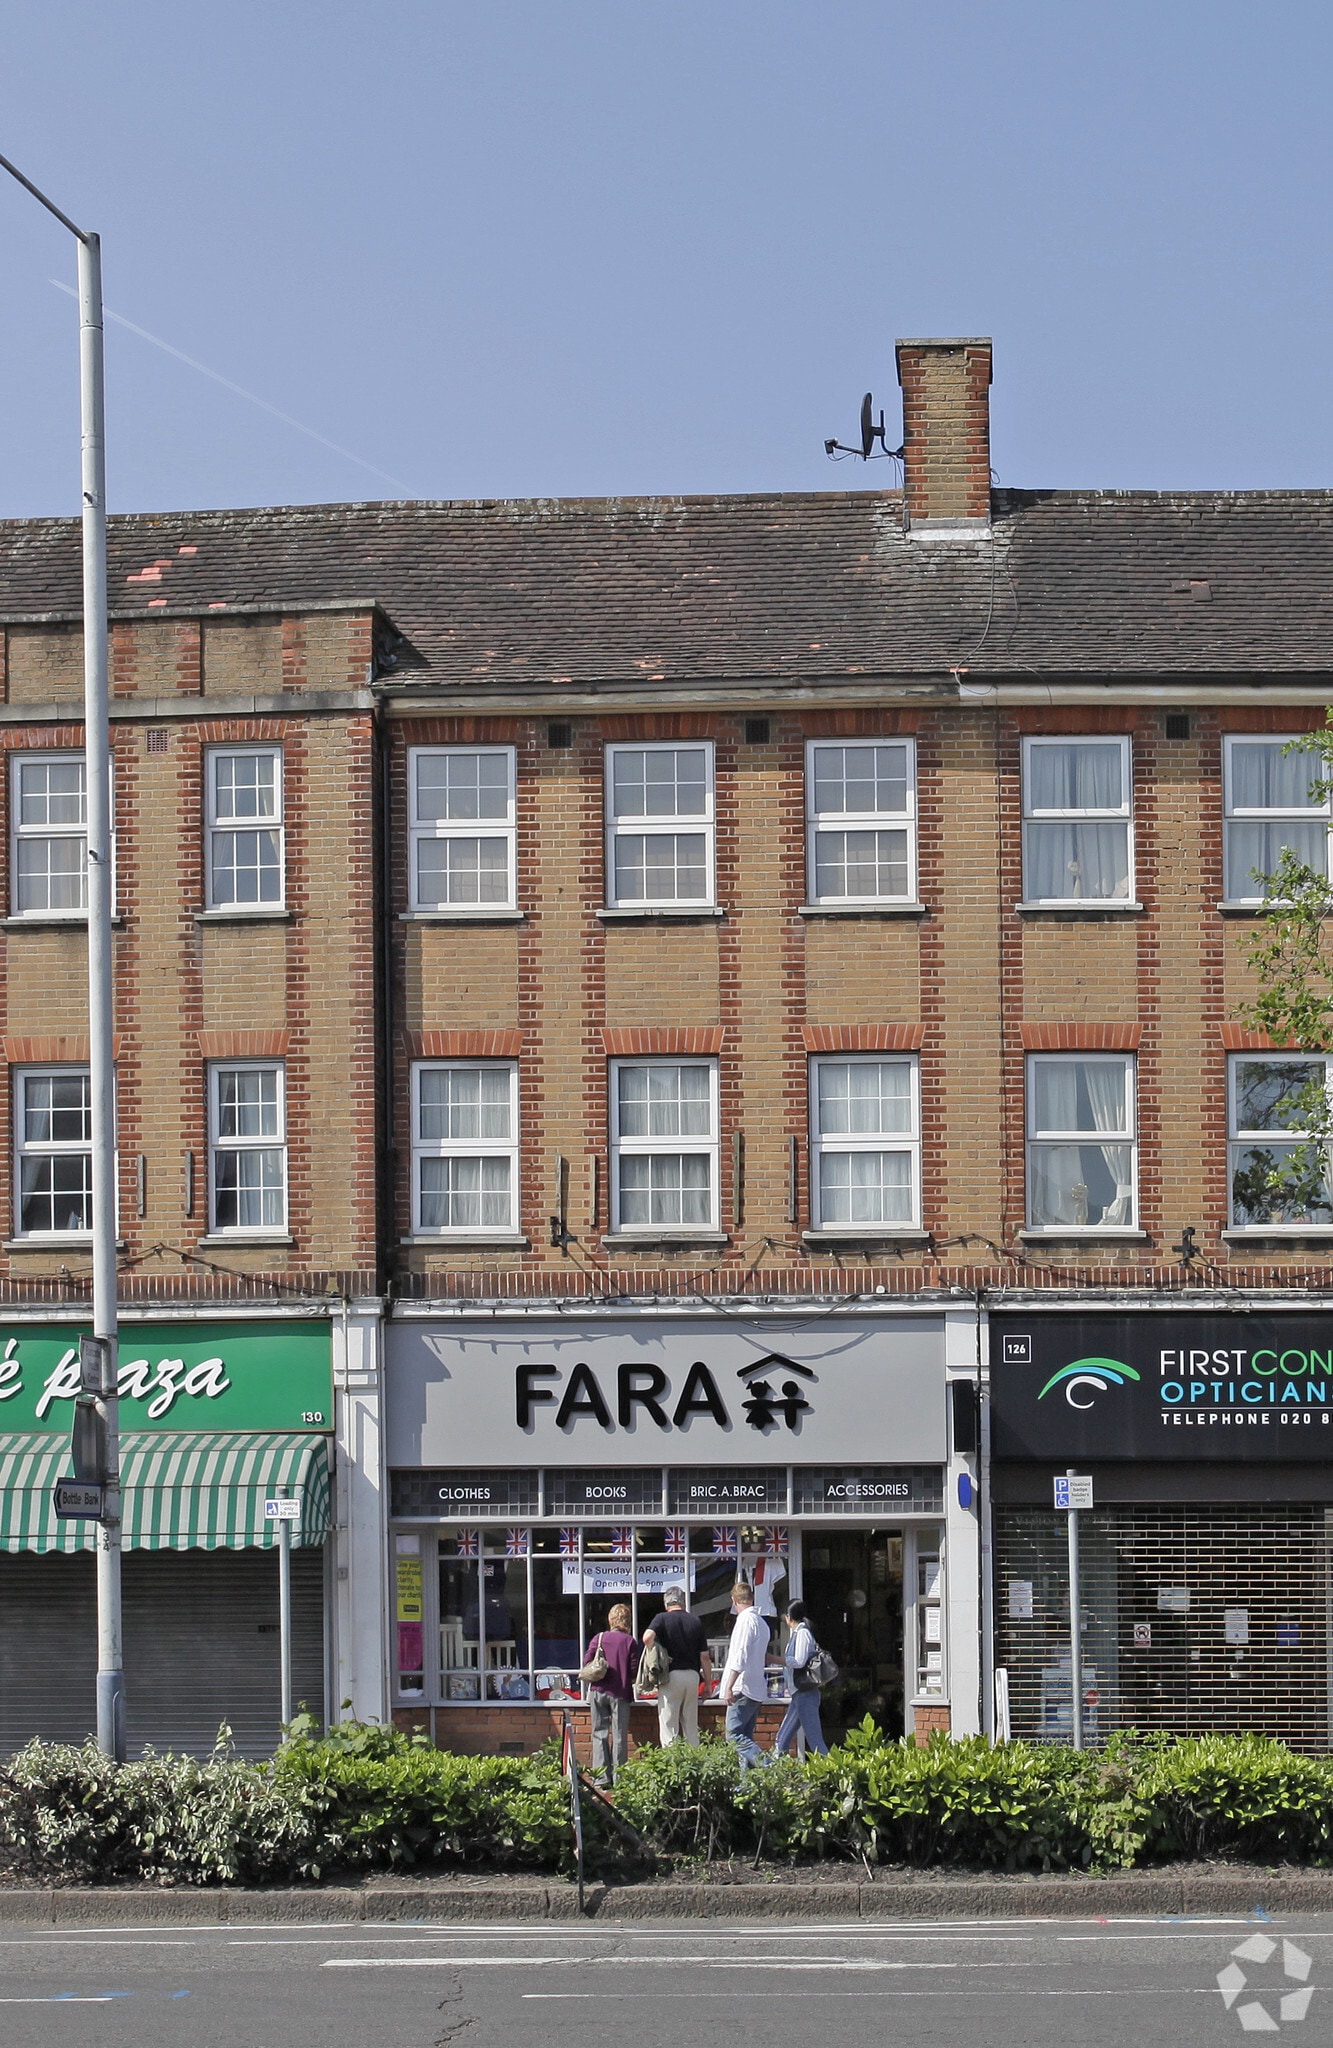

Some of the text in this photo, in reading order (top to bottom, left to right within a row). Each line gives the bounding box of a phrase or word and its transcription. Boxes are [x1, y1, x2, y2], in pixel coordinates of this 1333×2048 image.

[1007, 1344, 1026, 1354] 126
[1160, 1349, 1332, 1376] FIRST CON
[35, 1348, 230, 1419] paza
[516, 1362, 727, 1428] FARA
[1160, 1381, 1333, 1403] OPTICIAN
[301, 1411, 322, 1422] 130
[1161, 1413, 1271, 1425] TELEPHONE
[1280, 1413, 1311, 1425] 020
[690, 1485, 765, 1497] BRIC.A.BRAC
[827, 1484, 909, 1497] ACCESSORIES
[1058, 1480, 1068, 1491] P
[438, 1488, 491, 1500] CLOTHES
[586, 1486, 627, 1498] BOOKS
[62, 1491, 99, 1506] Bottle Bank
[595, 1566, 631, 1577] Sunday
[635, 1565, 660, 1574] ARA
[595, 1579, 618, 1588] Open
[645, 1579, 664, 1588] 5pm
